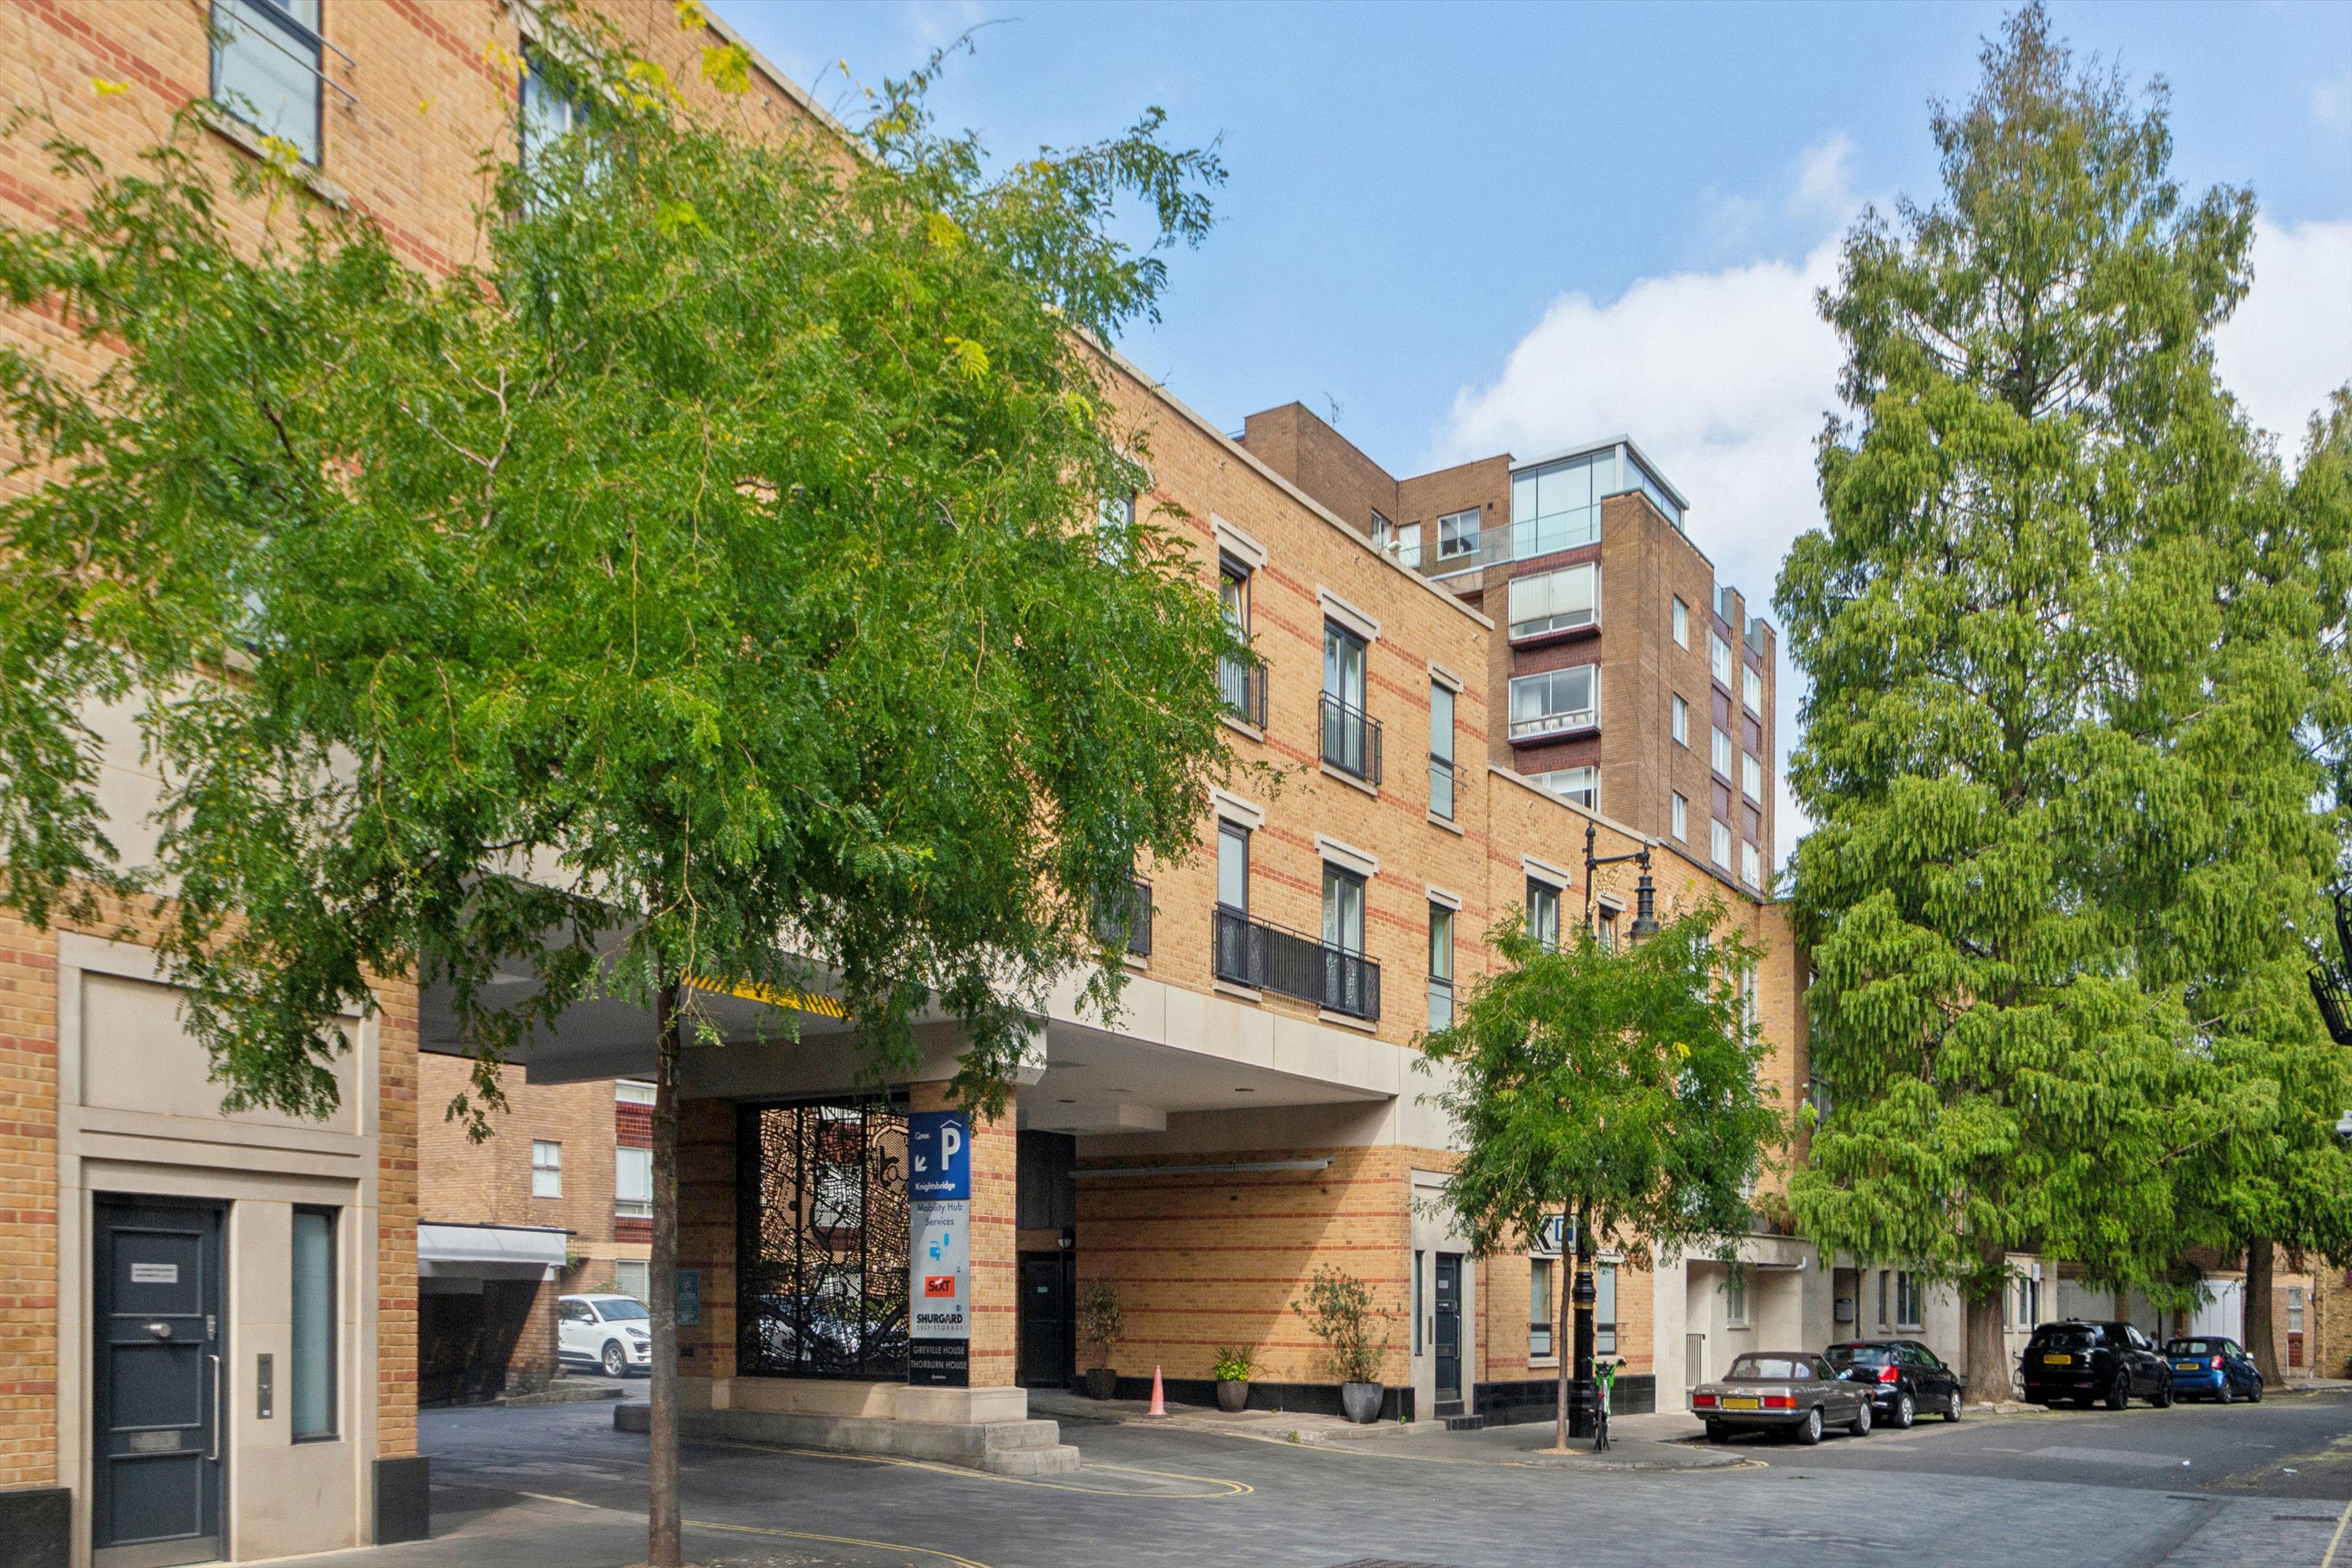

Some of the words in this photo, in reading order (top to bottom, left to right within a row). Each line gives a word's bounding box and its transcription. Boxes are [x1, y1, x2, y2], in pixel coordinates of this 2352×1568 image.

[942, 1127, 960, 1170] P
[915, 1180, 955, 1191] Knightsbridge
[917, 1202, 945, 1214] Mobility
[947, 1201, 963, 1211] Hub
[926, 1217, 954, 1225] Services
[917, 1314, 963, 1323] SHURGARD
[910, 1360, 944, 1368] THORBURN
